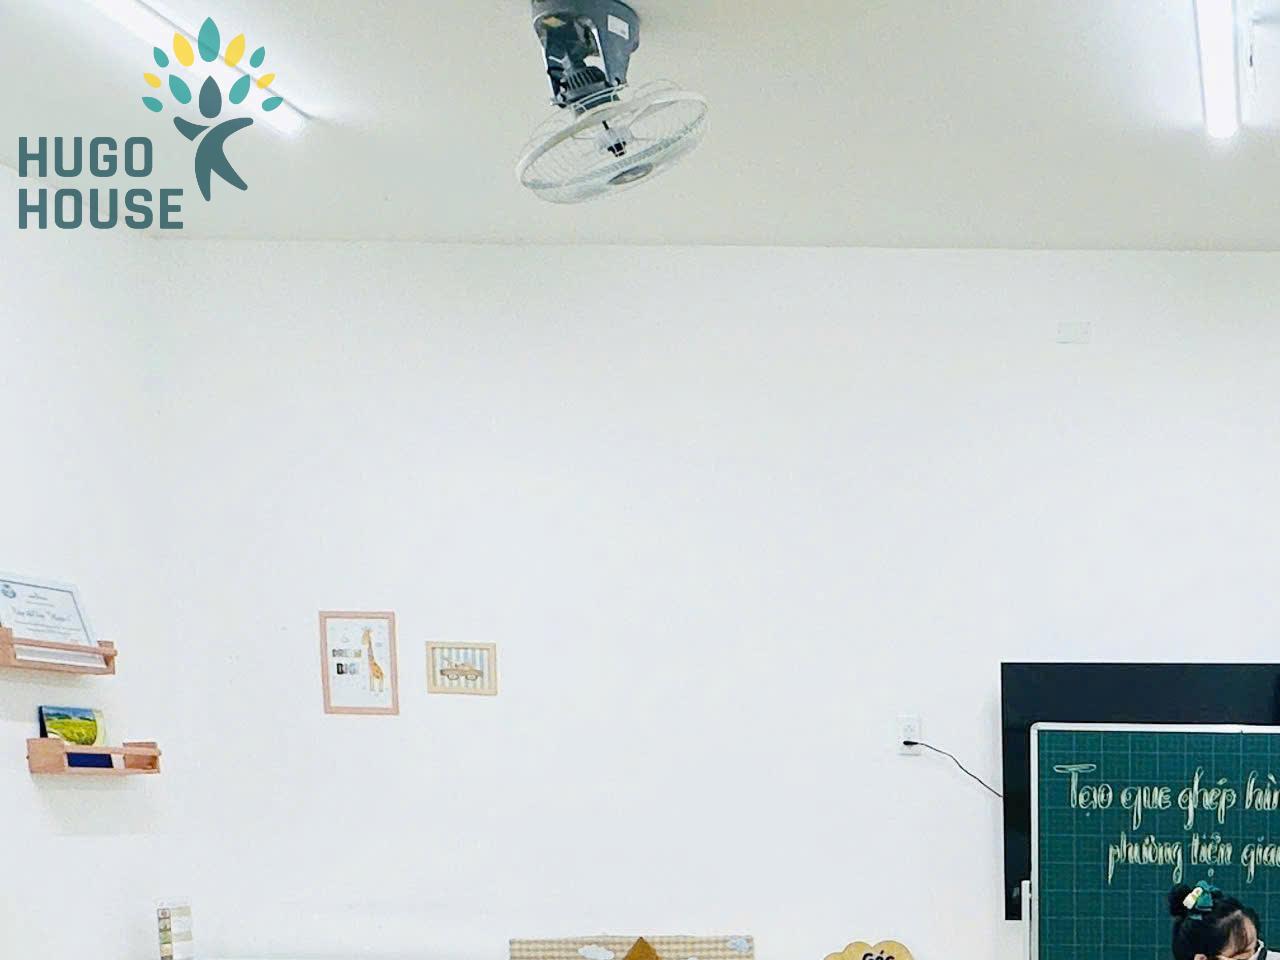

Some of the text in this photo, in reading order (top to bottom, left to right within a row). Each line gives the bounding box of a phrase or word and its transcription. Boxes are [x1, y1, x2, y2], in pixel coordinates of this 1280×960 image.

[1053, 764, 1113, 817] Tạo
[1120, 785, 1172, 831] que
[1178, 766, 1237, 831] ghép
[1190, 832, 1233, 878] tiện
